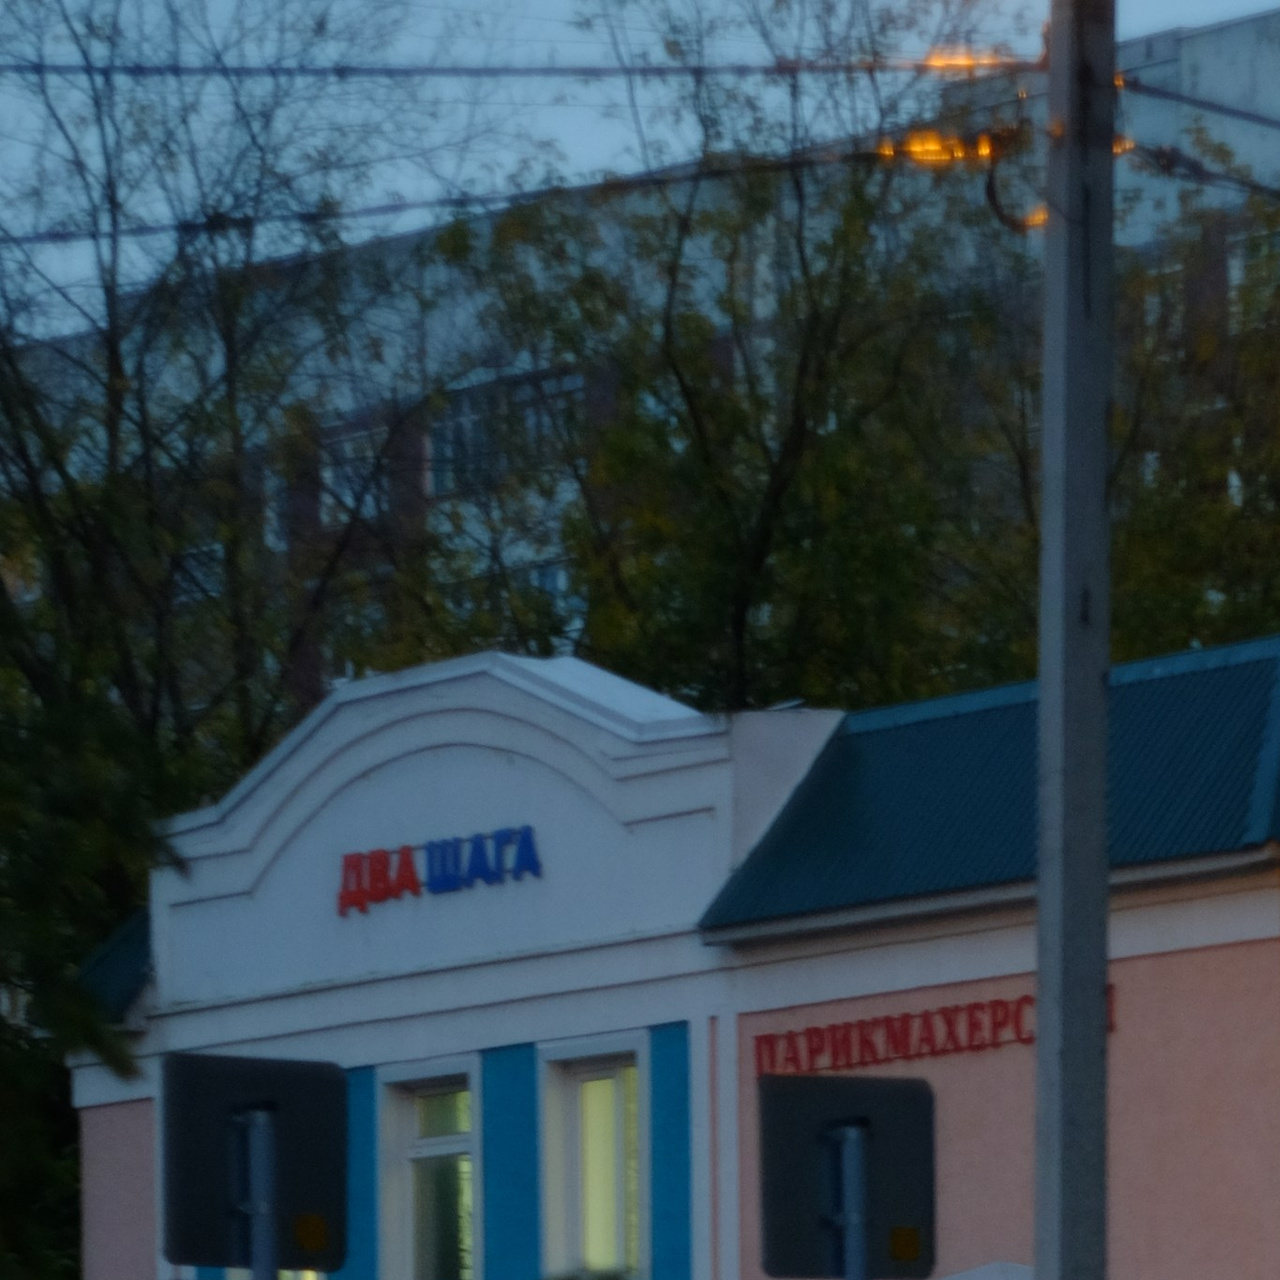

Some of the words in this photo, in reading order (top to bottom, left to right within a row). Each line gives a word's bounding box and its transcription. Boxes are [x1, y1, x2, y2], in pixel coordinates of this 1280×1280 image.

[338, 845, 421, 917] ДВА
[425, 825, 541, 894] ШАГА
[754, 984, 1115, 1078] ПАРИКМАХЕРС
